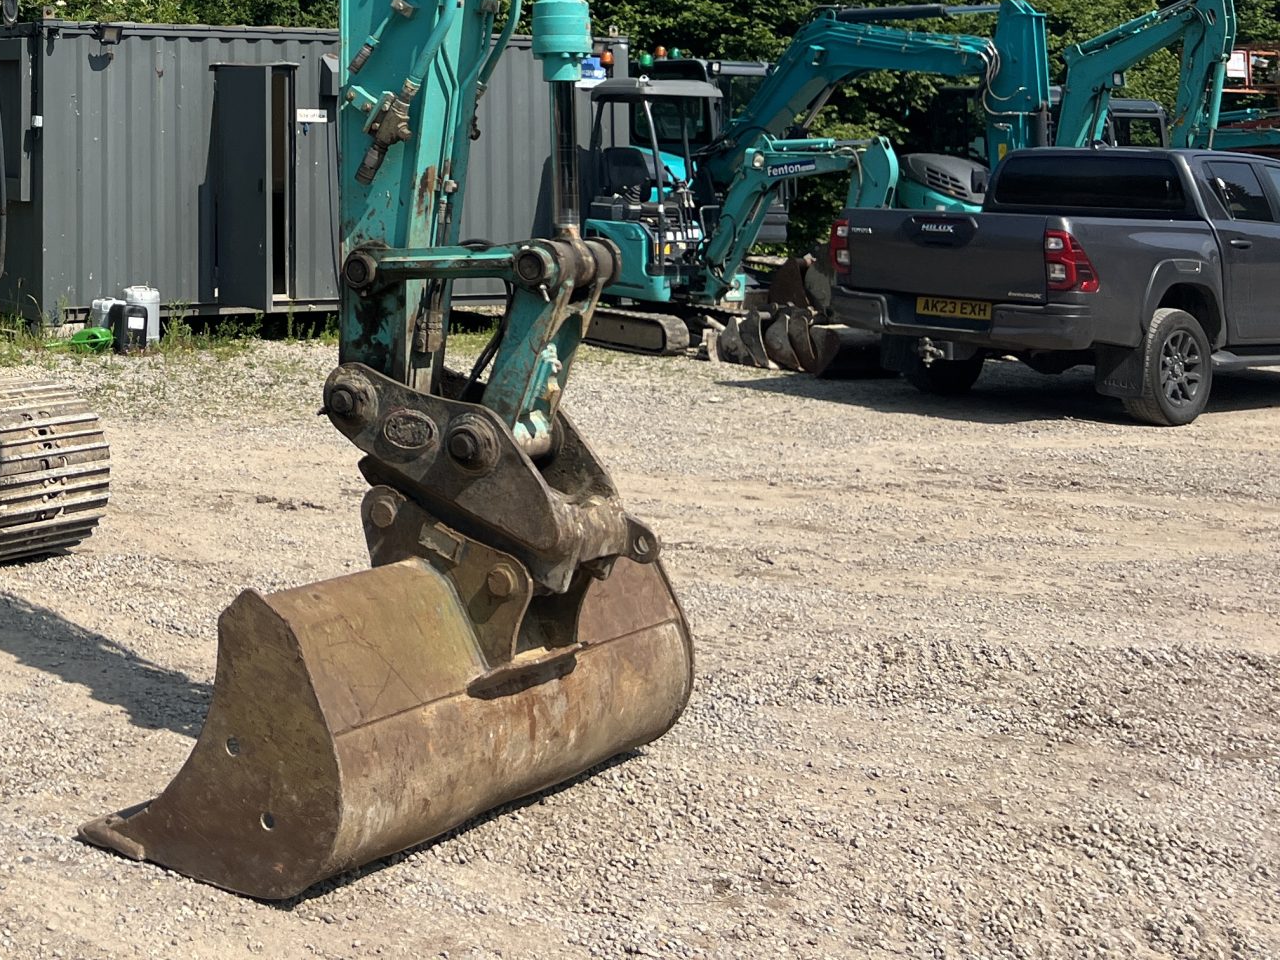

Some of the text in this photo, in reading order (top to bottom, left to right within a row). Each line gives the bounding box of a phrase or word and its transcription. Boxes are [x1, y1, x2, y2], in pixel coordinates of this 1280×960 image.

[767, 164, 801, 176] Fenton
[921, 224, 954, 233] HILUX
[922, 299, 987, 316] AK23 EXH
